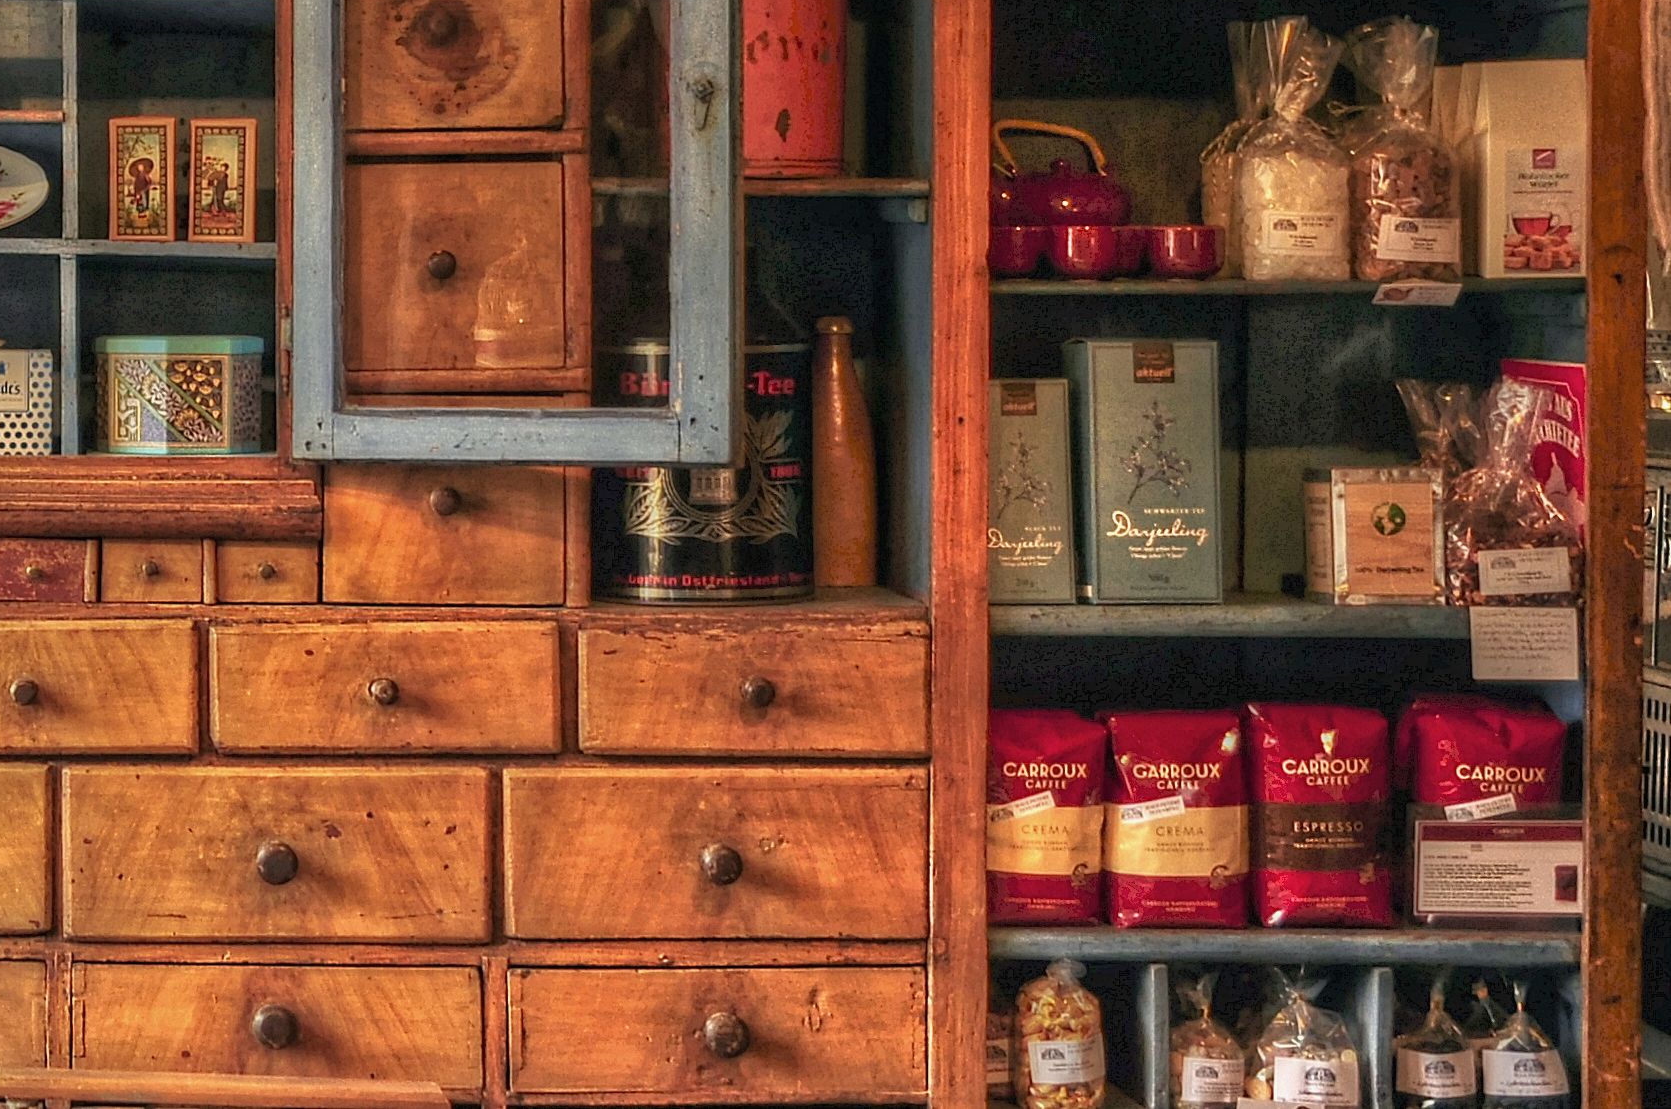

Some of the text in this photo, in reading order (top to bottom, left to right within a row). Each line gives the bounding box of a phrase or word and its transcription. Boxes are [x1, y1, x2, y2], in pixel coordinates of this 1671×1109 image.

[1107, 510, 1209, 546] Darjeeling
[988, 528, 1063, 554] Darjeeling
[1003, 762, 1088, 778] CARROUX
[1281, 758, 1370, 775] CARROUX
[1455, 764, 1546, 783] CARROUX
[1021, 825, 1070, 835] CREMA
[1155, 826, 1204, 837] CREMA
[1293, 821, 1364, 833] ESPRESSO
